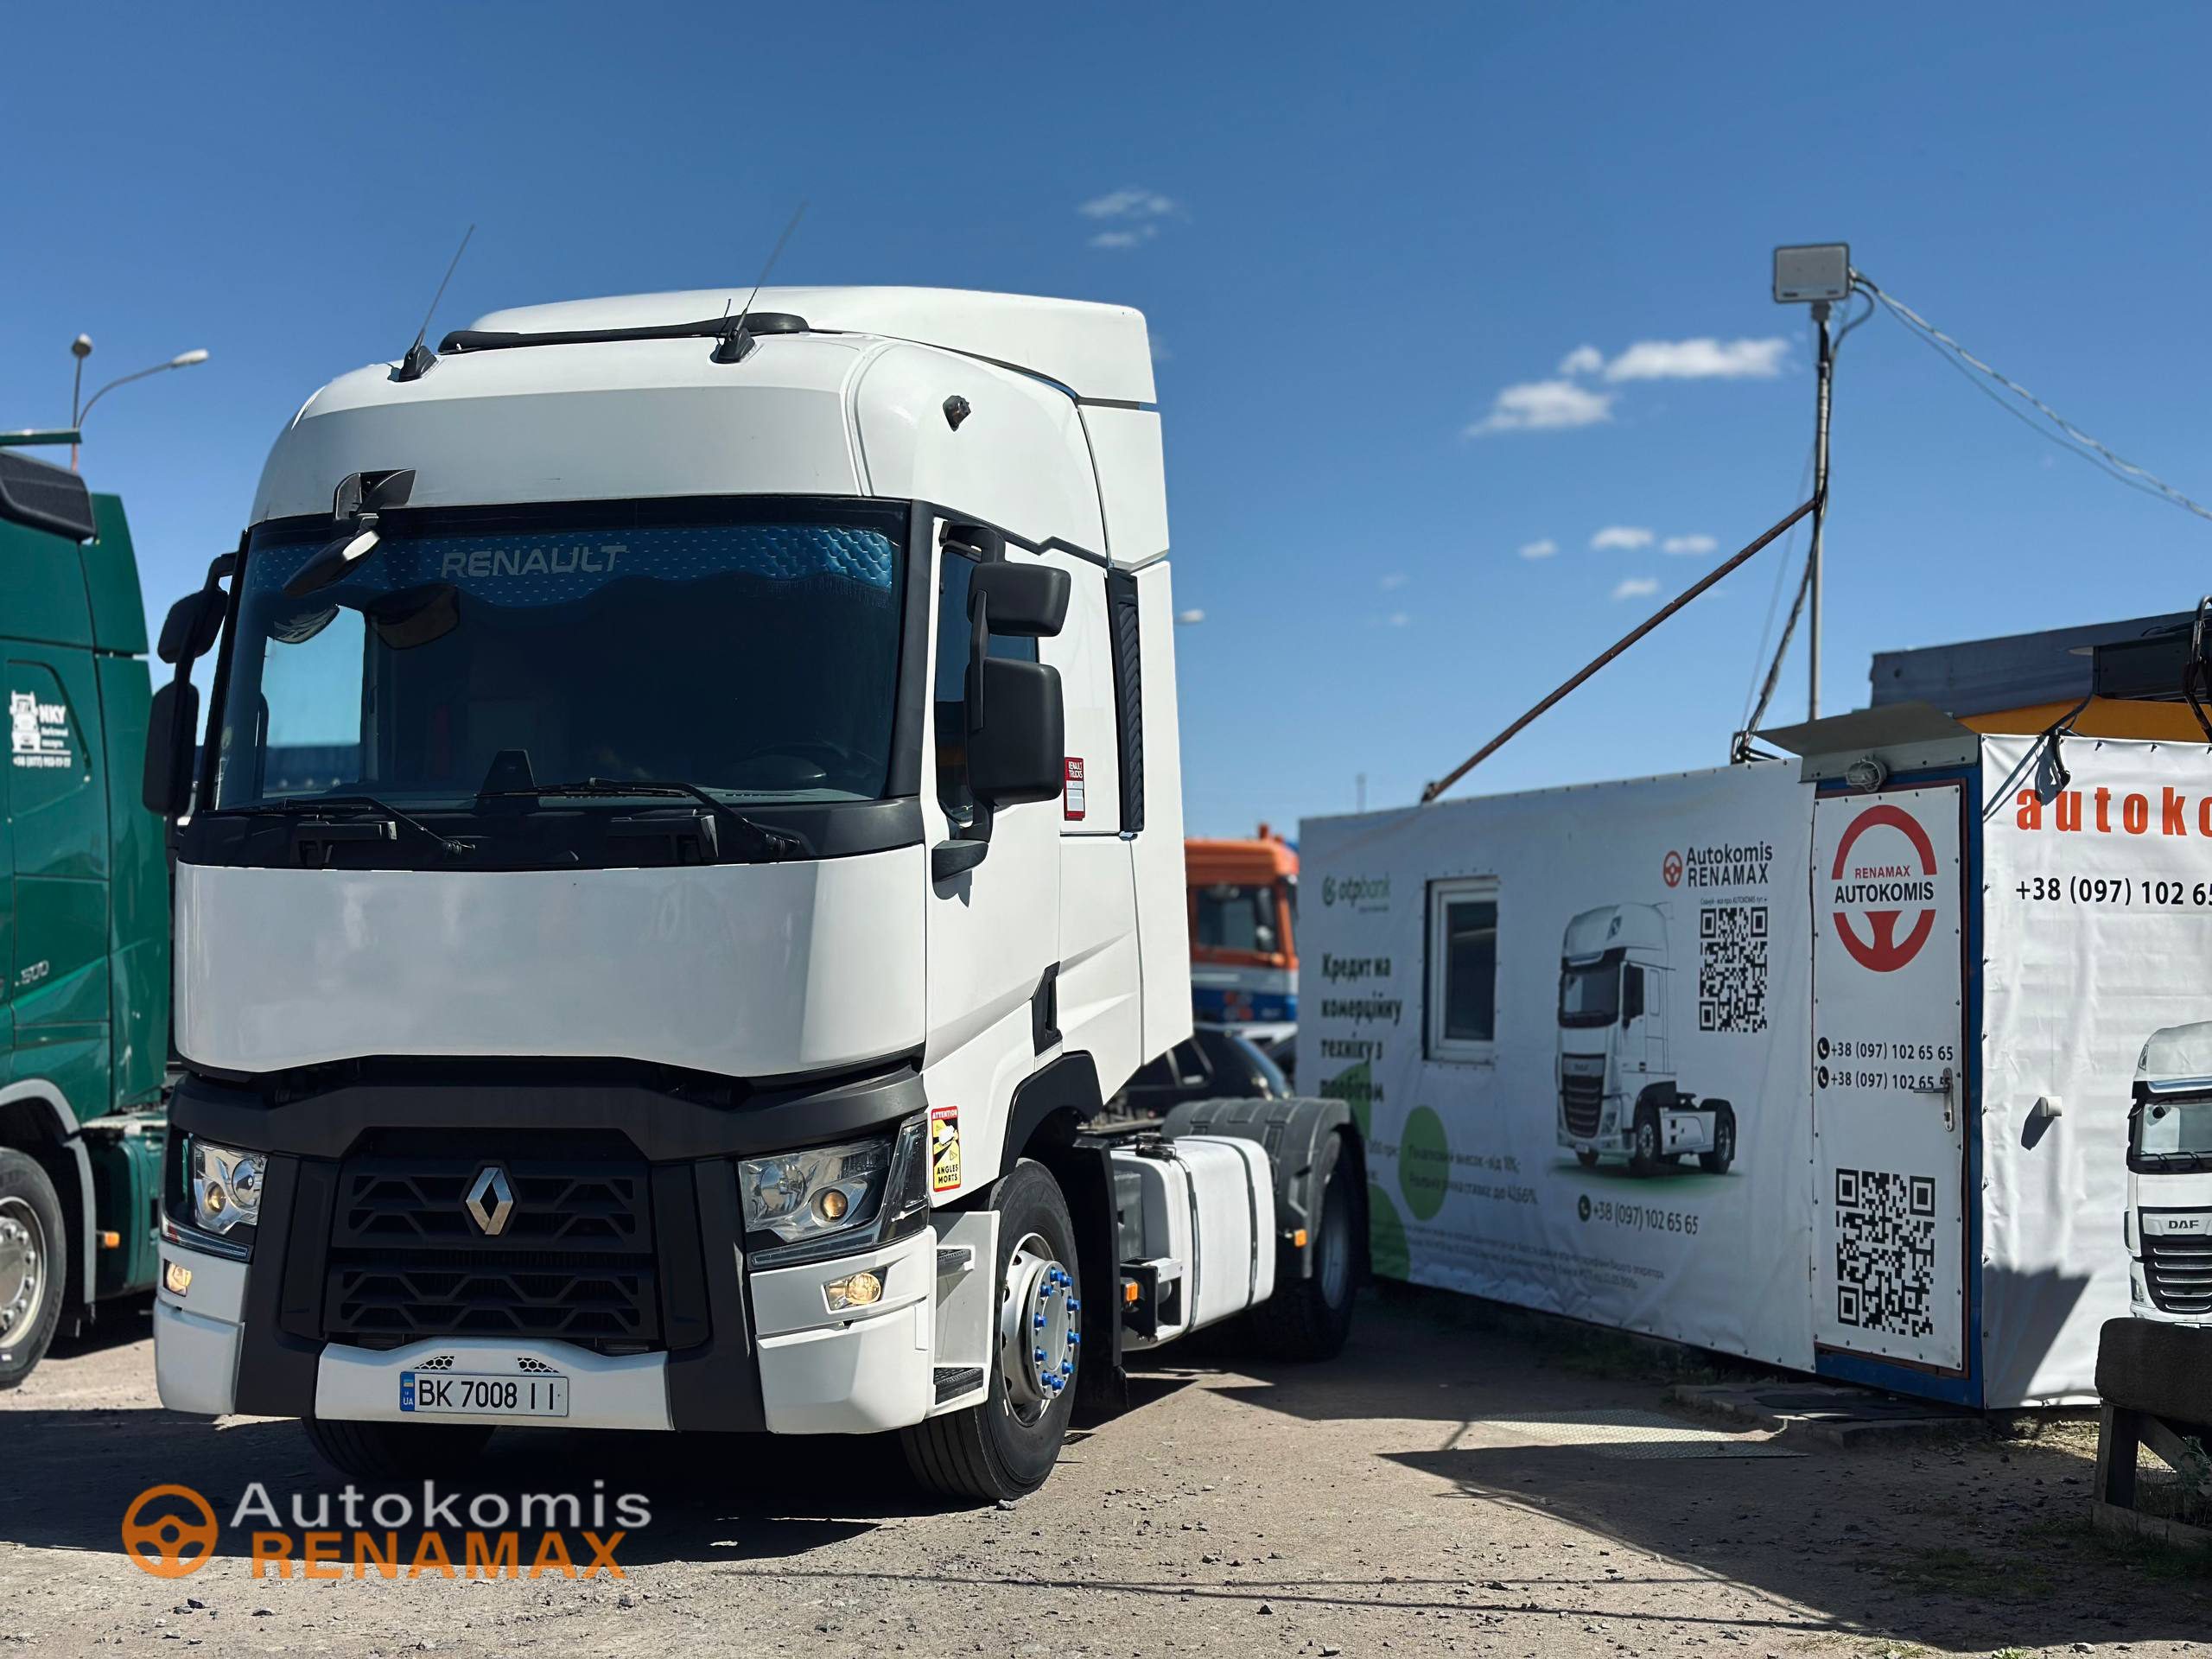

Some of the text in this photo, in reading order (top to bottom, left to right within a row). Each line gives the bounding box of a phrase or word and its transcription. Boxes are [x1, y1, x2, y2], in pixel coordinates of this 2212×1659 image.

[441, 545, 628, 578] RENAULT
[1686, 841, 1773, 866] Autokomis
[1688, 863, 1769, 887] RENAMAX
[1854, 865, 1911, 880] RENAMAX
[1834, 881, 1935, 904] AUTOKOMIS
[2016, 877, 2061, 900] +38
[2070, 876, 2132, 906] (097)
[2142, 880, 2184, 905] 102
[1831, 1041, 1953, 1061] +38 (097) 102 65 65
[1831, 1071, 1852, 1086] +38
[1856, 1071, 1887, 1090] (097)
[1892, 1075, 1915, 1090] 102
[1919, 1075, 1934, 1089] 65
[937, 1164, 958, 1175] ANGLES
[938, 1173, 957, 1184] MORTS
[1594, 1201, 1699, 1235] +38 (097) 102 65 65
[2168, 1220, 2199, 1229] DAF
[403, 1397, 414, 1406] UA
[419, 1380, 453, 1408] BK
[461, 1381, 518, 1408] 7008
